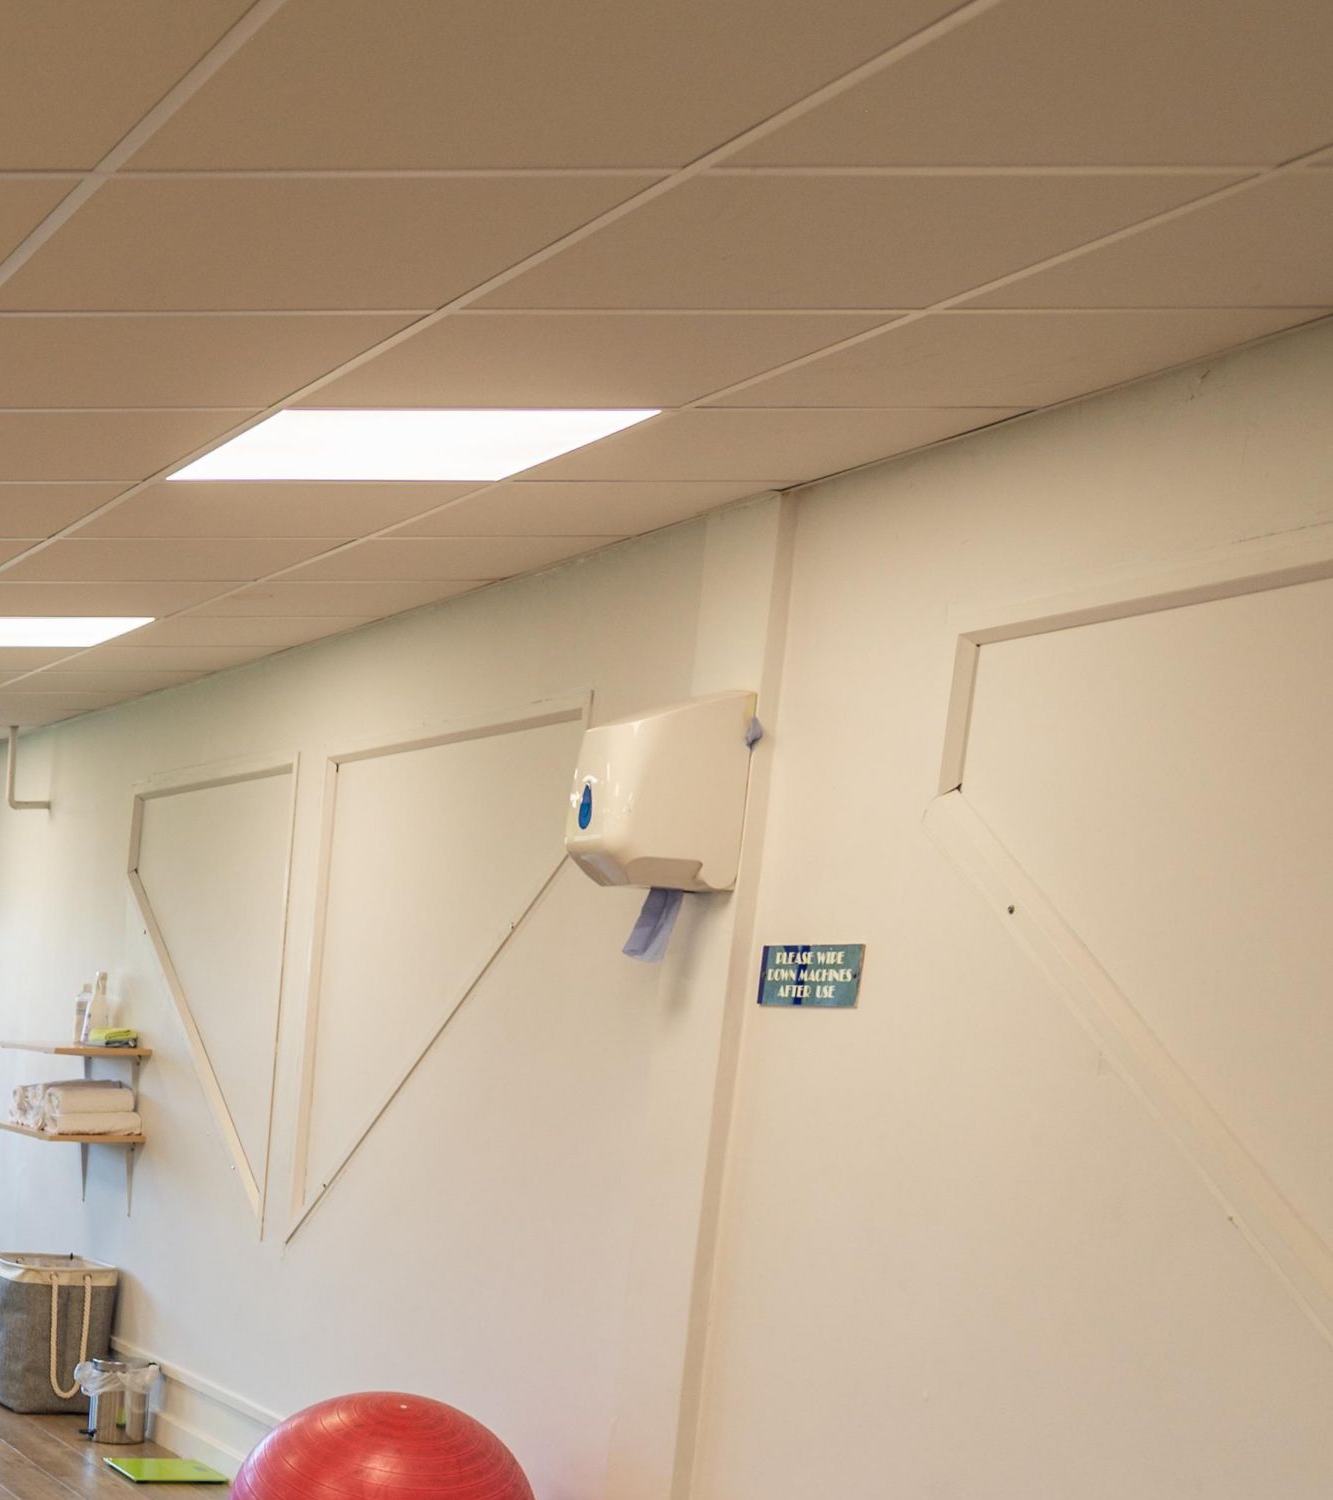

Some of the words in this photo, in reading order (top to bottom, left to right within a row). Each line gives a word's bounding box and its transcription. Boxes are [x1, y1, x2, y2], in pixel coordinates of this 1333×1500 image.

[776, 952, 813, 964] PLEASE
[817, 951, 845, 964] WIPE
[767, 969, 795, 981] DOWN
[798, 969, 852, 982] MACHINES
[777, 985, 811, 998] AFTER
[815, 985, 836, 998] USE
